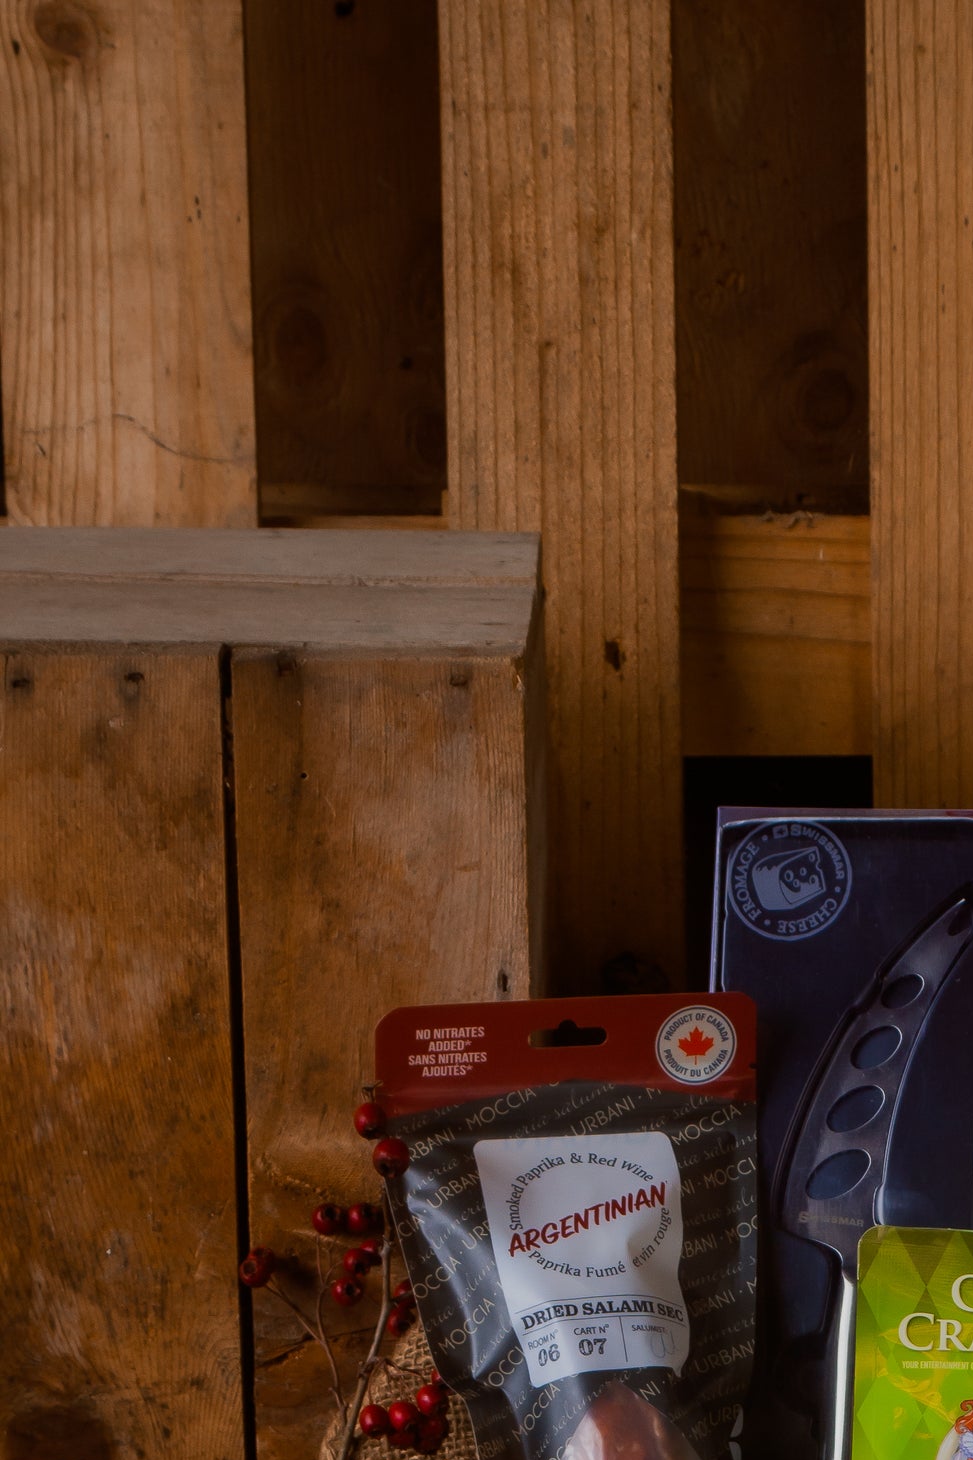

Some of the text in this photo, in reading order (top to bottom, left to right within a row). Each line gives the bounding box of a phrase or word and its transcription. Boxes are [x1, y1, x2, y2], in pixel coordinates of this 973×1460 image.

[735, 842, 762, 921] FROMAGE
[777, 898, 838, 934] CHEESE
[415, 1026, 485, 1041] NO NITRATES
[664, 1013, 729, 1042] PRODUCT OF CANADA
[408, 1052, 488, 1066] SANS NITRATES
[663, 1048, 728, 1077] PRODUIT DU CANADA
[465, 1088, 537, 1131] MOCCIA
[571, 1095, 636, 1137] URBANI
[671, 1103, 742, 1146] MOCCIA
[506, 1184, 524, 1231] Smoked
[516, 1156, 565, 1186] Paprika
[570, 1152, 583, 1164] &
[588, 1153, 617, 1168] Red
[620, 1160, 654, 1182] Wine
[508, 1181, 665, 1257] ARGENTINIAN
[528, 1250, 581, 1277] Paprika
[586, 1261, 627, 1278] Fumé
[640, 1245, 656, 1263] vin
[654, 1207, 672, 1245] rouge
[438, 1297, 497, 1354] MOCCIA
[520, 1300, 684, 1330] DRIED SALAMI SEC
[573, 1326, 596, 1336] CART
[527, 1335, 551, 1351] ROOM
[538, 1343, 561, 1367] 06
[578, 1338, 607, 1356] 07
[901, 1360, 919, 1369] YOUR
[920, 1360, 969, 1370] ENTERTAINMENT
[512, 1383, 561, 1443] MOCCIA
